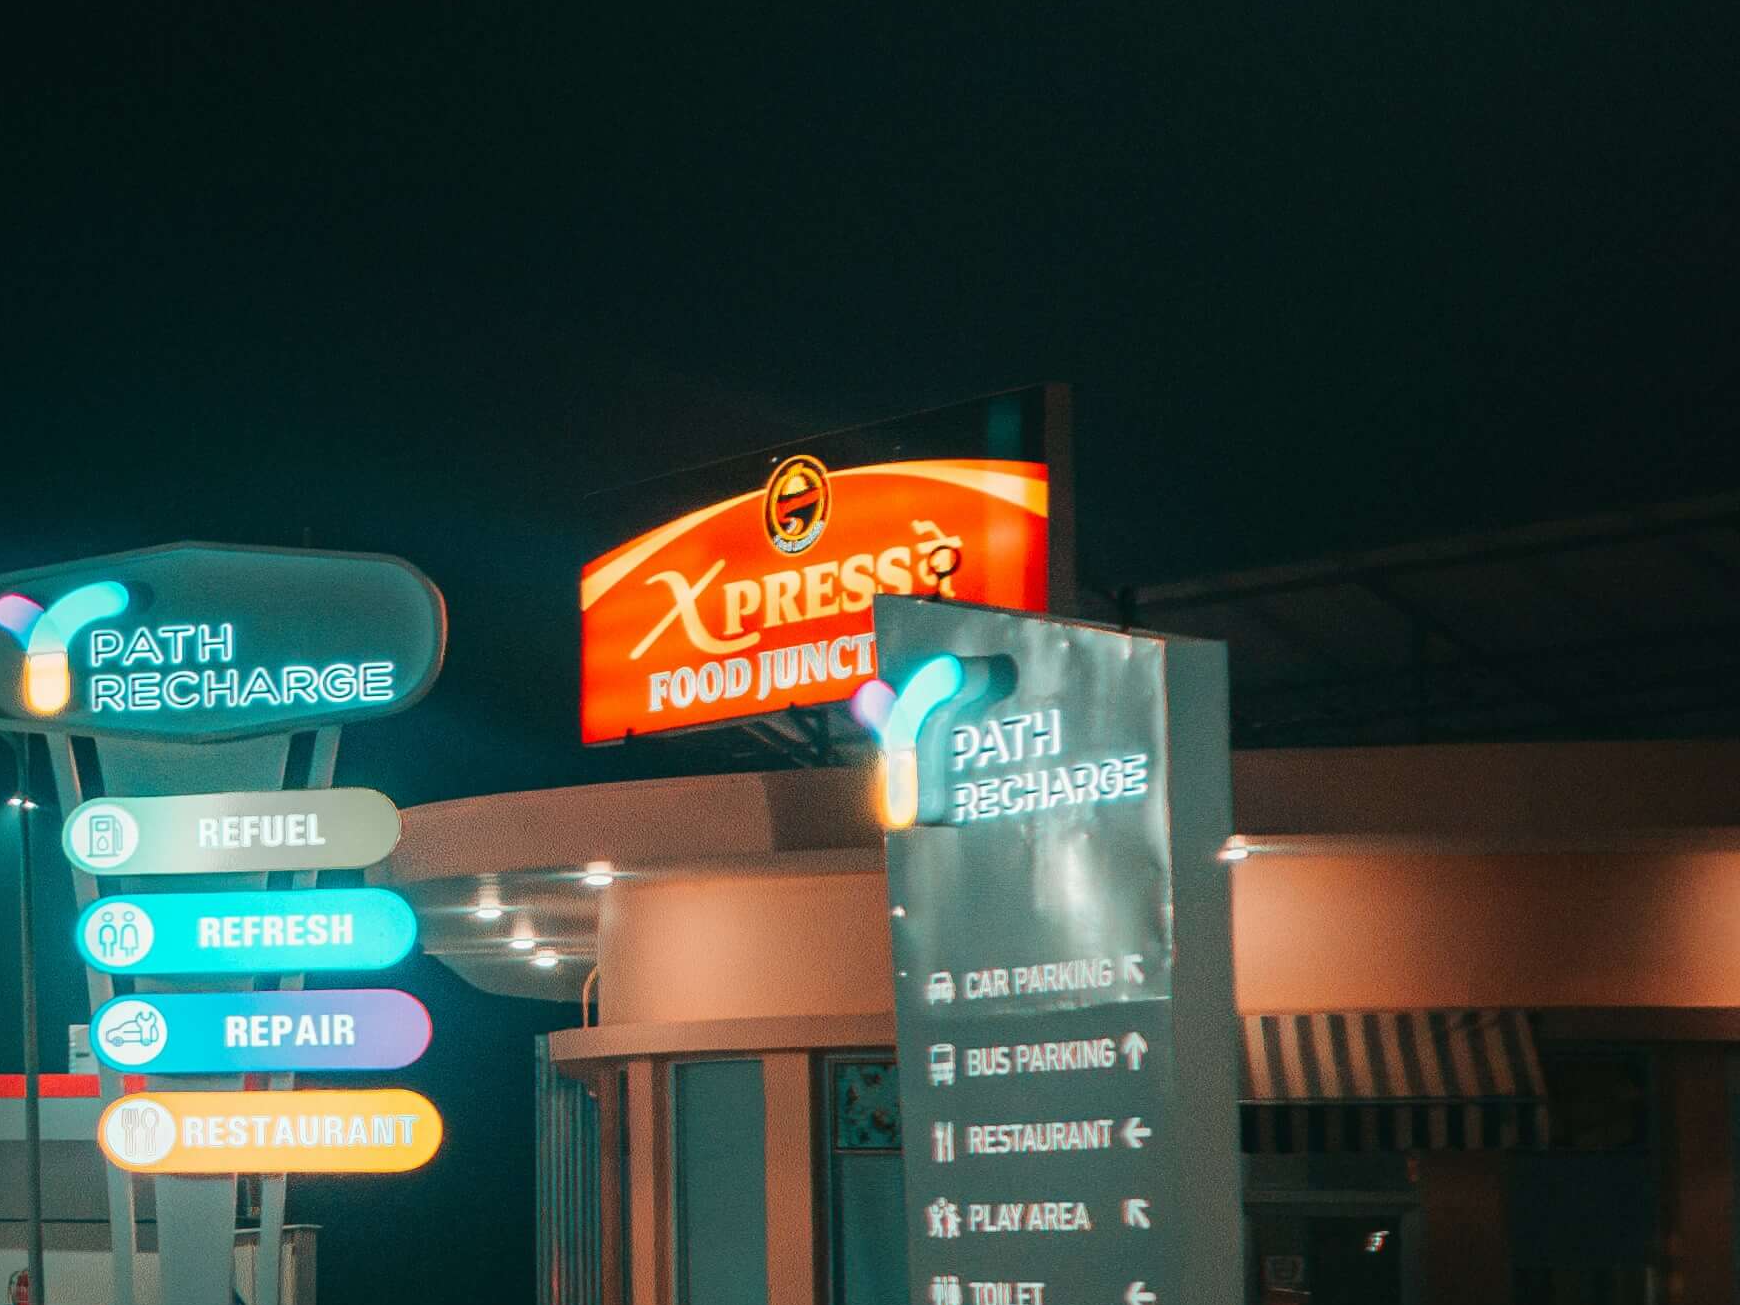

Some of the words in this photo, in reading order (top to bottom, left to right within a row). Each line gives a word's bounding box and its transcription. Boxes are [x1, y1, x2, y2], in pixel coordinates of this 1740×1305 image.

[90, 623, 233, 668] PATH
[90, 661, 395, 713] RECHARGE
[648, 656, 752, 713] FOOD
[757, 632, 876, 700] JUNCT
[952, 709, 1061, 771] PATH
[952, 752, 1149, 823] RECHARGE
[199, 813, 326, 848] REFUEL
[199, 913, 354, 948] REFRESH
[965, 967, 1010, 999] CAR
[1013, 958, 1115, 994] PARKING
[225, 1014, 355, 1047] REPAIR
[966, 1046, 1011, 1077] BUS
[1015, 1038, 1116, 1073] PARKING
[182, 1114, 420, 1147] RESTAURANT
[966, 1119, 1114, 1154] RESTAURANT
[969, 1203, 1025, 1232] PLAY
[1027, 1202, 1092, 1231] AREA
